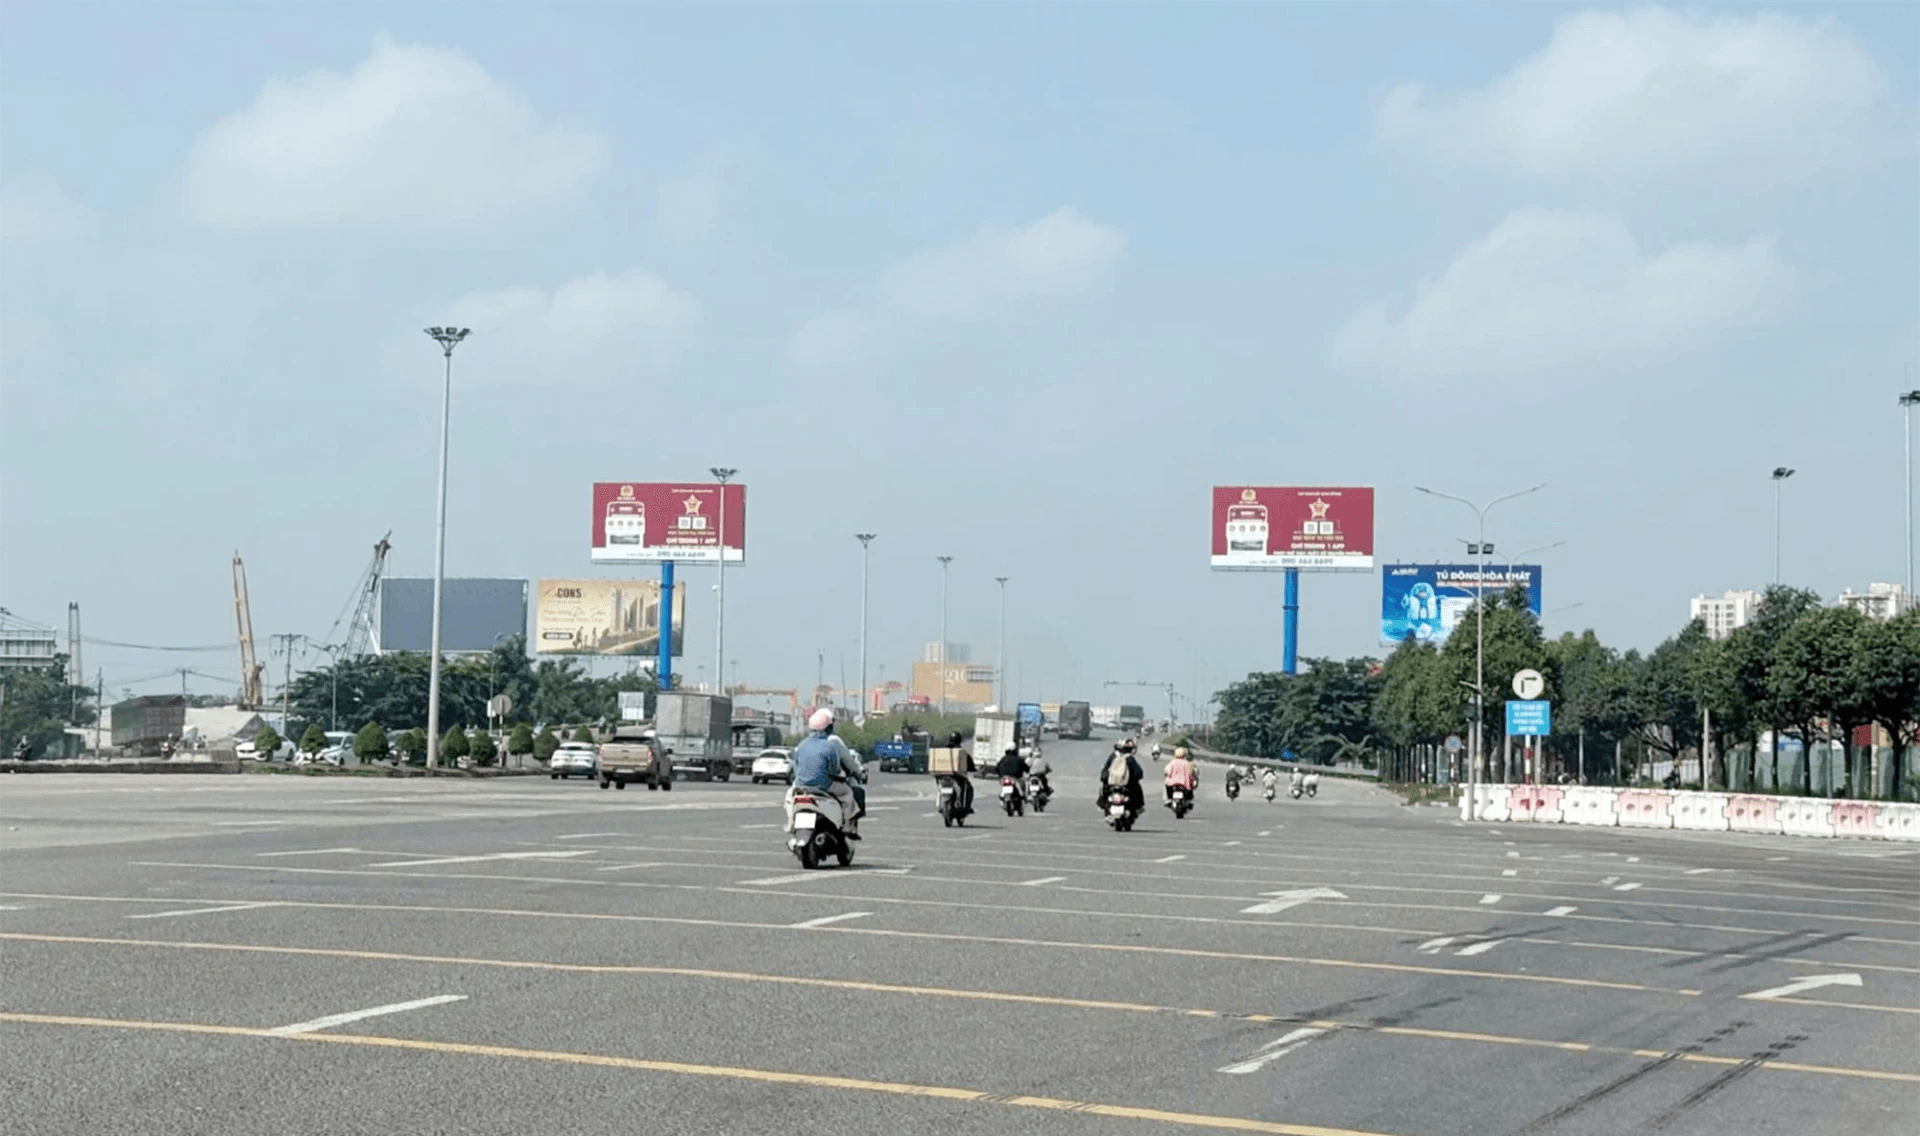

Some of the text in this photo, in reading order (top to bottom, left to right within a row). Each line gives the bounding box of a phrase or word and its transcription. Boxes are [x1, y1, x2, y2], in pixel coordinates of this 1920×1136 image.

[1436, 569, 1531, 580] TỦ ĐÔNG HÒA PHÁT
